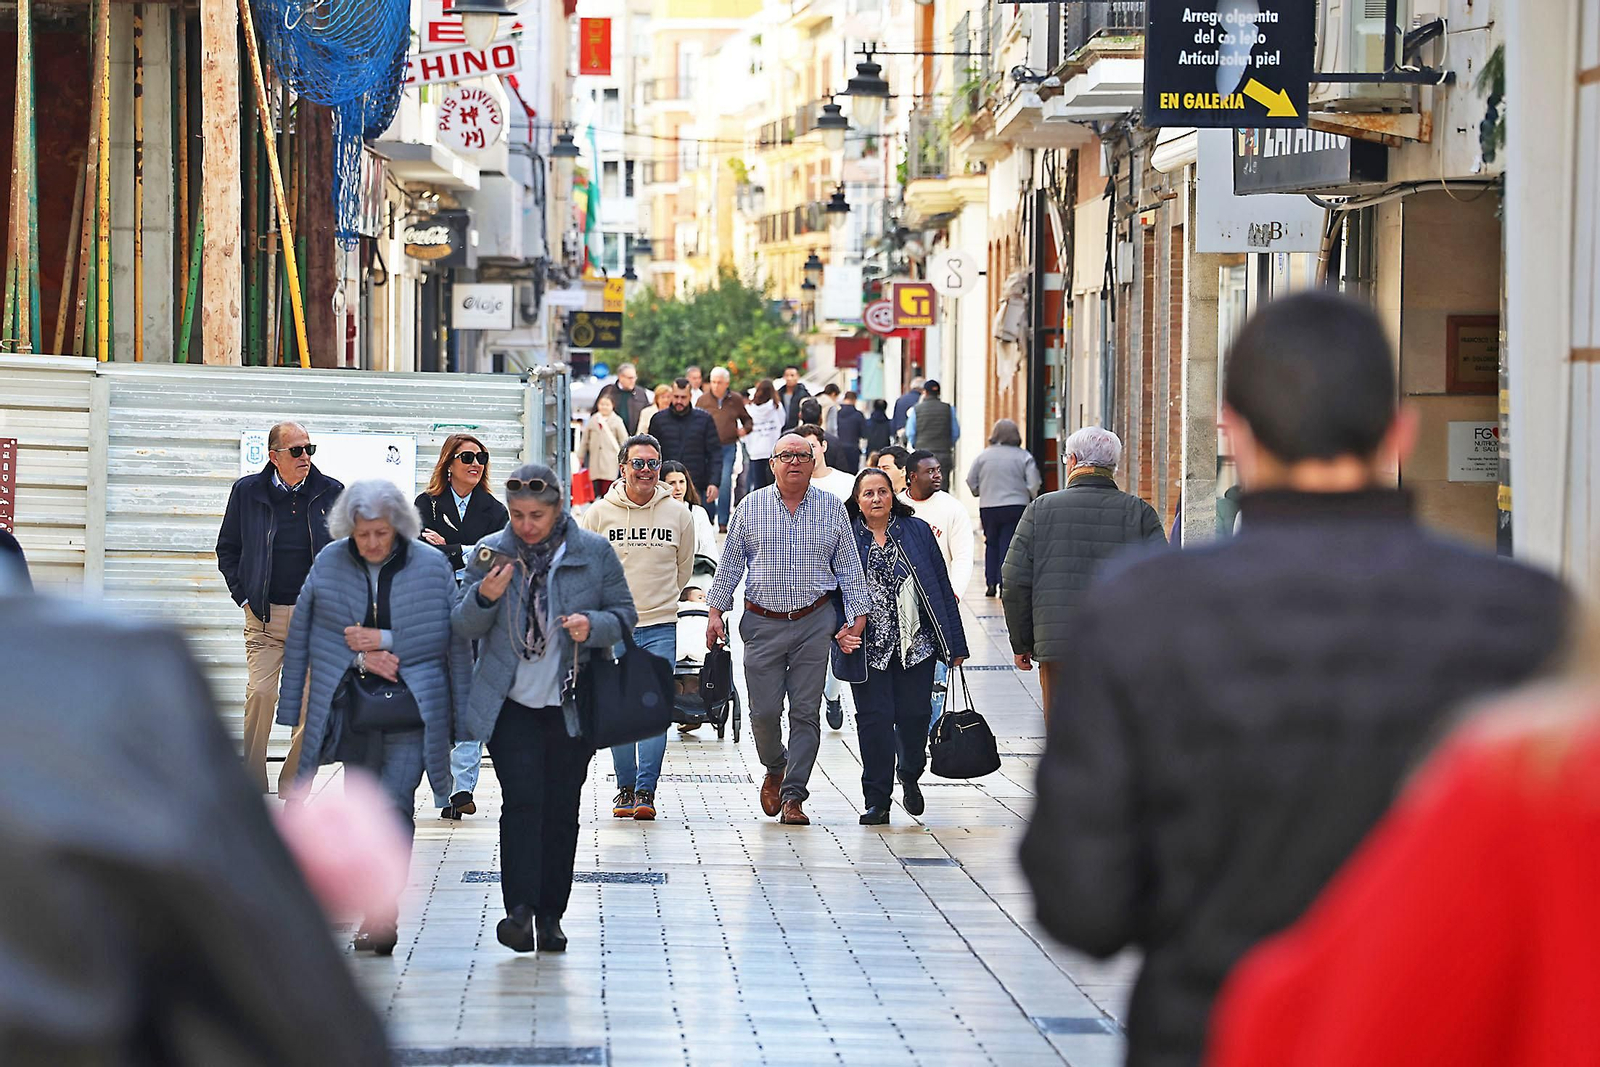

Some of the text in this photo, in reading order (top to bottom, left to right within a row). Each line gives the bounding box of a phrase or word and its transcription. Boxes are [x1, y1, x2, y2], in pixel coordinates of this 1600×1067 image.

[1194, 28, 1215, 44] del
[1255, 50, 1281, 69] piel
[1160, 93, 1179, 109] EN
[1474, 427, 1493, 440] FG
